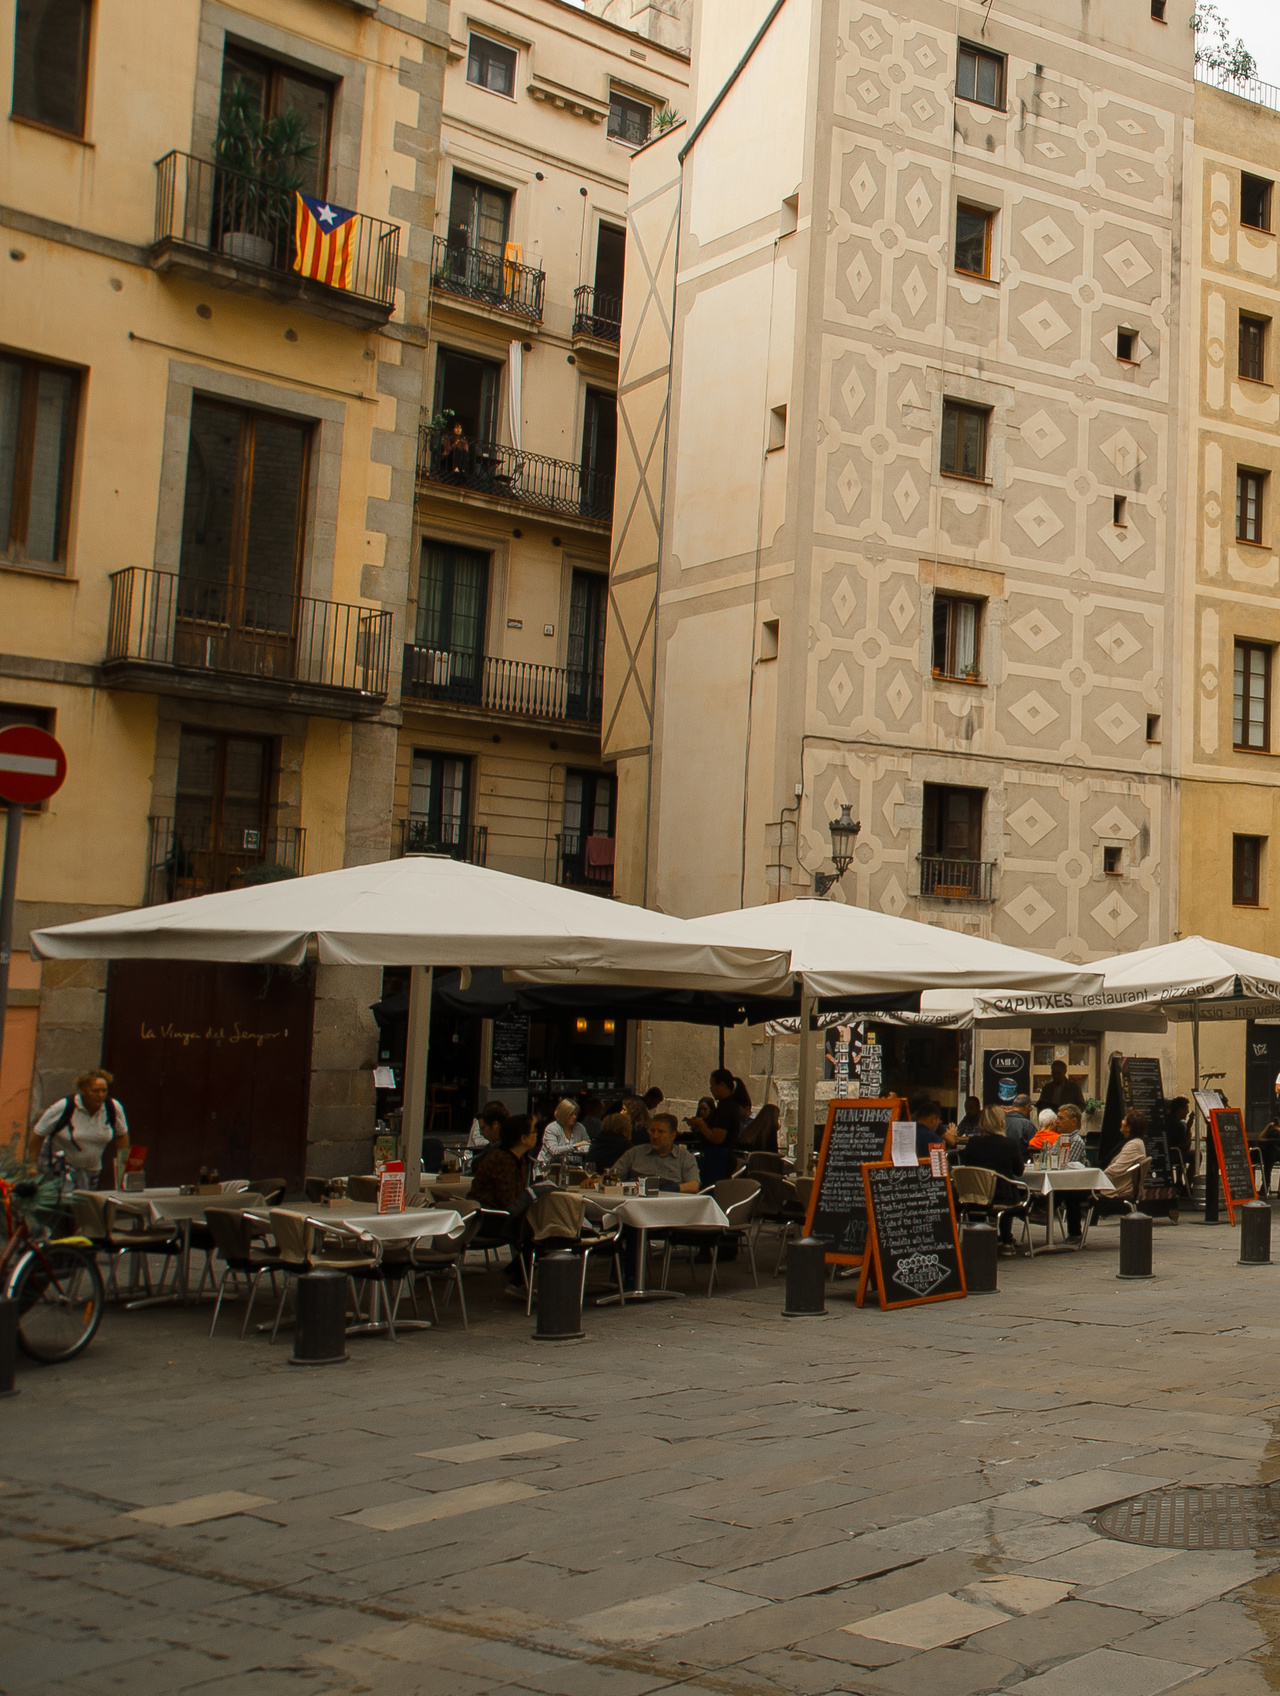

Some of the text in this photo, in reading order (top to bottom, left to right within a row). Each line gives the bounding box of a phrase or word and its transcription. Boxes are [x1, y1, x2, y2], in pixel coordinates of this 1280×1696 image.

[993, 993, 1073, 1014] CAPUTXES
[1082, 988, 1148, 1007] restaurant
[1160, 983, 1215, 1002] pizzeria
[913, 1012, 960, 1025] pizzeria
[205, 1027, 225, 1039] del
